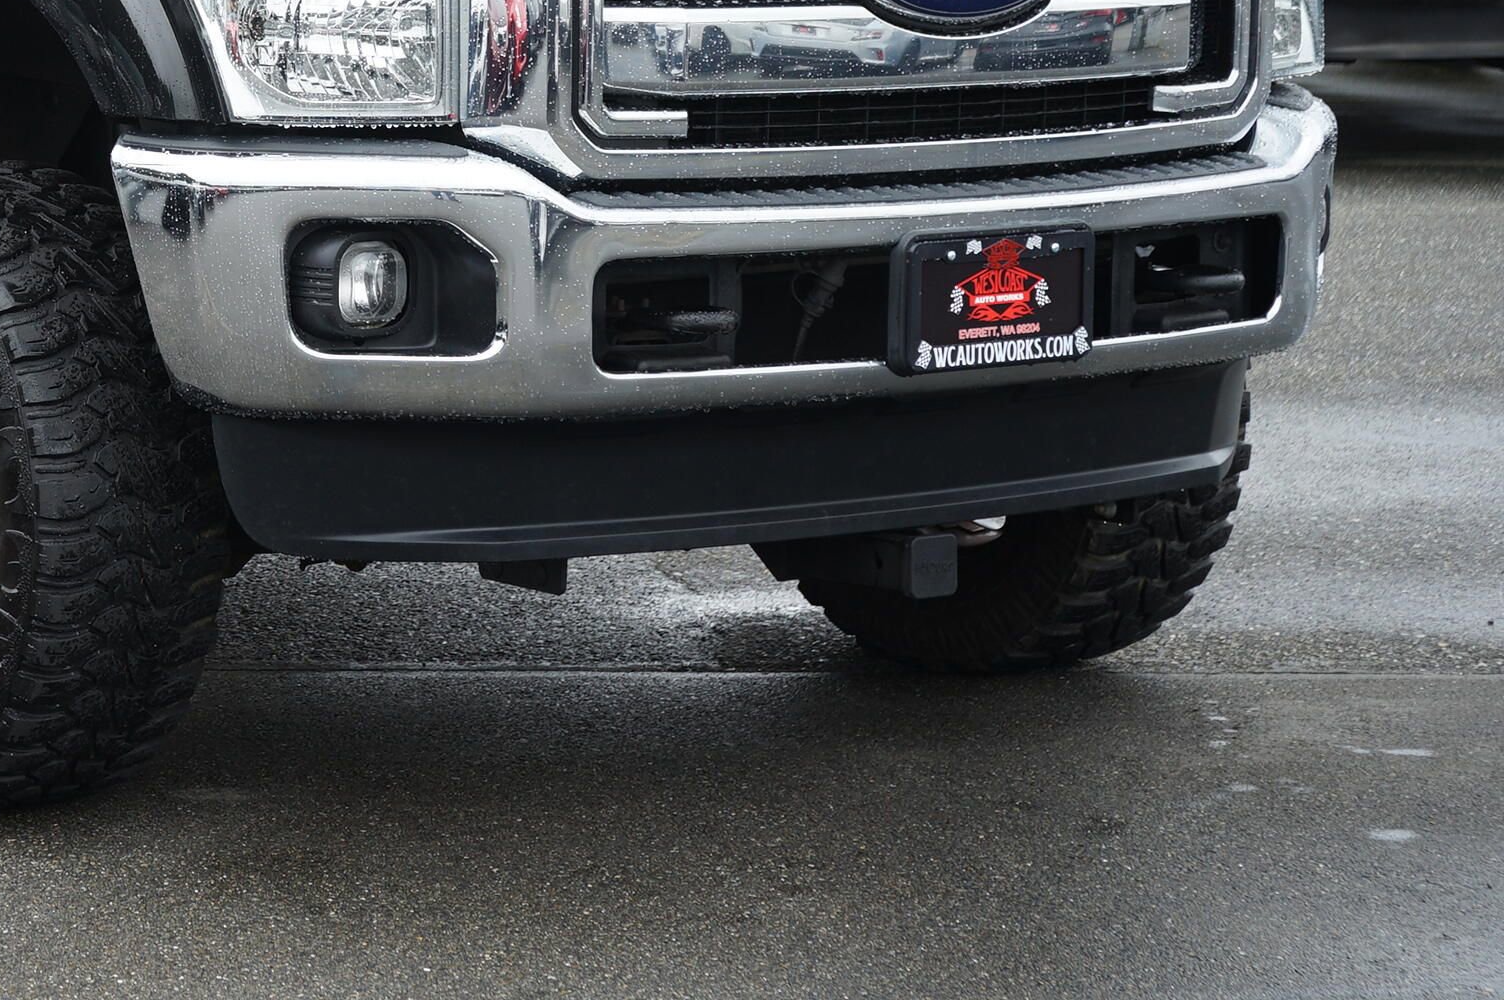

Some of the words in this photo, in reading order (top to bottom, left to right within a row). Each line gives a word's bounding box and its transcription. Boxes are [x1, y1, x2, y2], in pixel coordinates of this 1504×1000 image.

[972, 269, 999, 294] WEST
[999, 268, 1028, 292] COAST
[974, 295, 995, 304] AUTO
[996, 293, 1024, 303] WORKS
[958, 326, 1000, 339] EVERETT,
[1000, 324, 1015, 336] WA
[1016, 322, 1040, 334] 98204
[933, 334, 1074, 368] WCAUTOWORKS.COM
